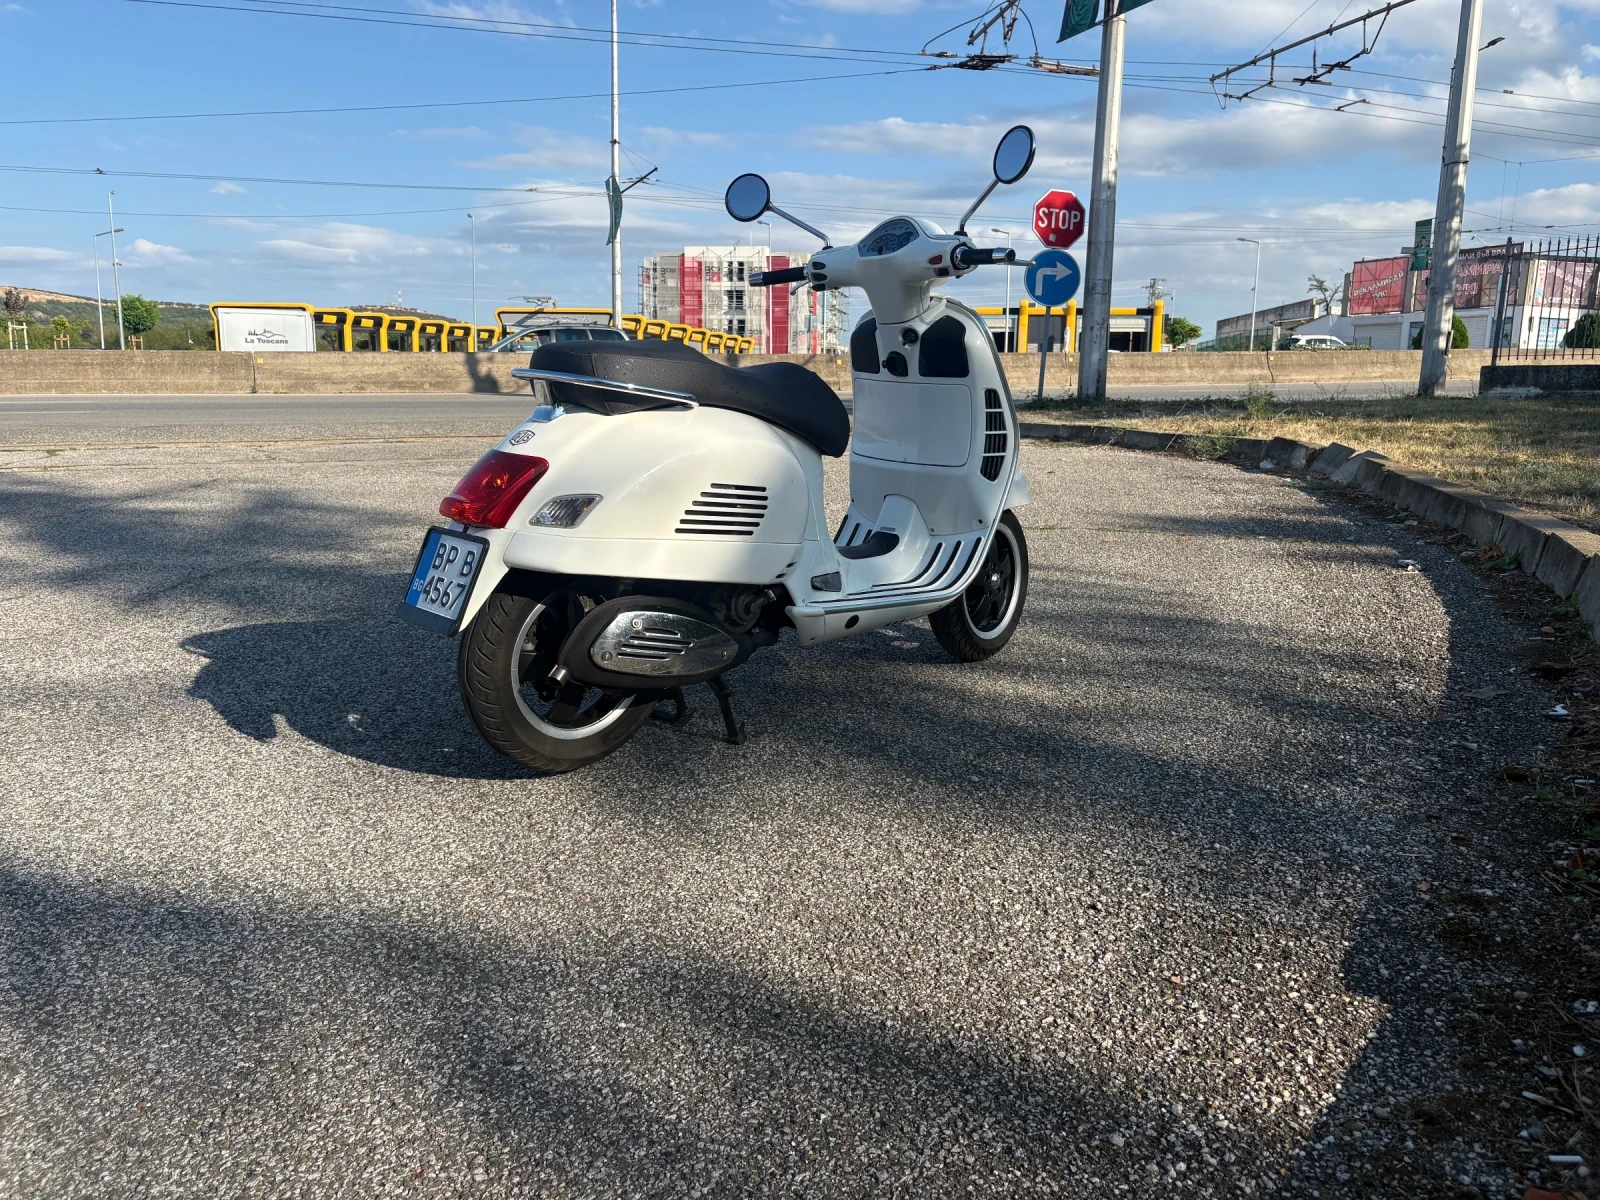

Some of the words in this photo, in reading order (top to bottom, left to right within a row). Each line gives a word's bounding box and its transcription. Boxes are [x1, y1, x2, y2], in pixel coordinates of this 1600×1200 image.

[1038, 207, 1081, 231] STOP
[1491, 247, 1518, 257] ВРАА
[1353, 270, 1404, 297] РЕКЛАМИРАЙ
[256, 337, 289, 345] Toscana
[432, 542, 460, 573] BP
[460, 550, 477, 577] B
[412, 578, 424, 592] BG
[422, 574, 467, 611] 4567
